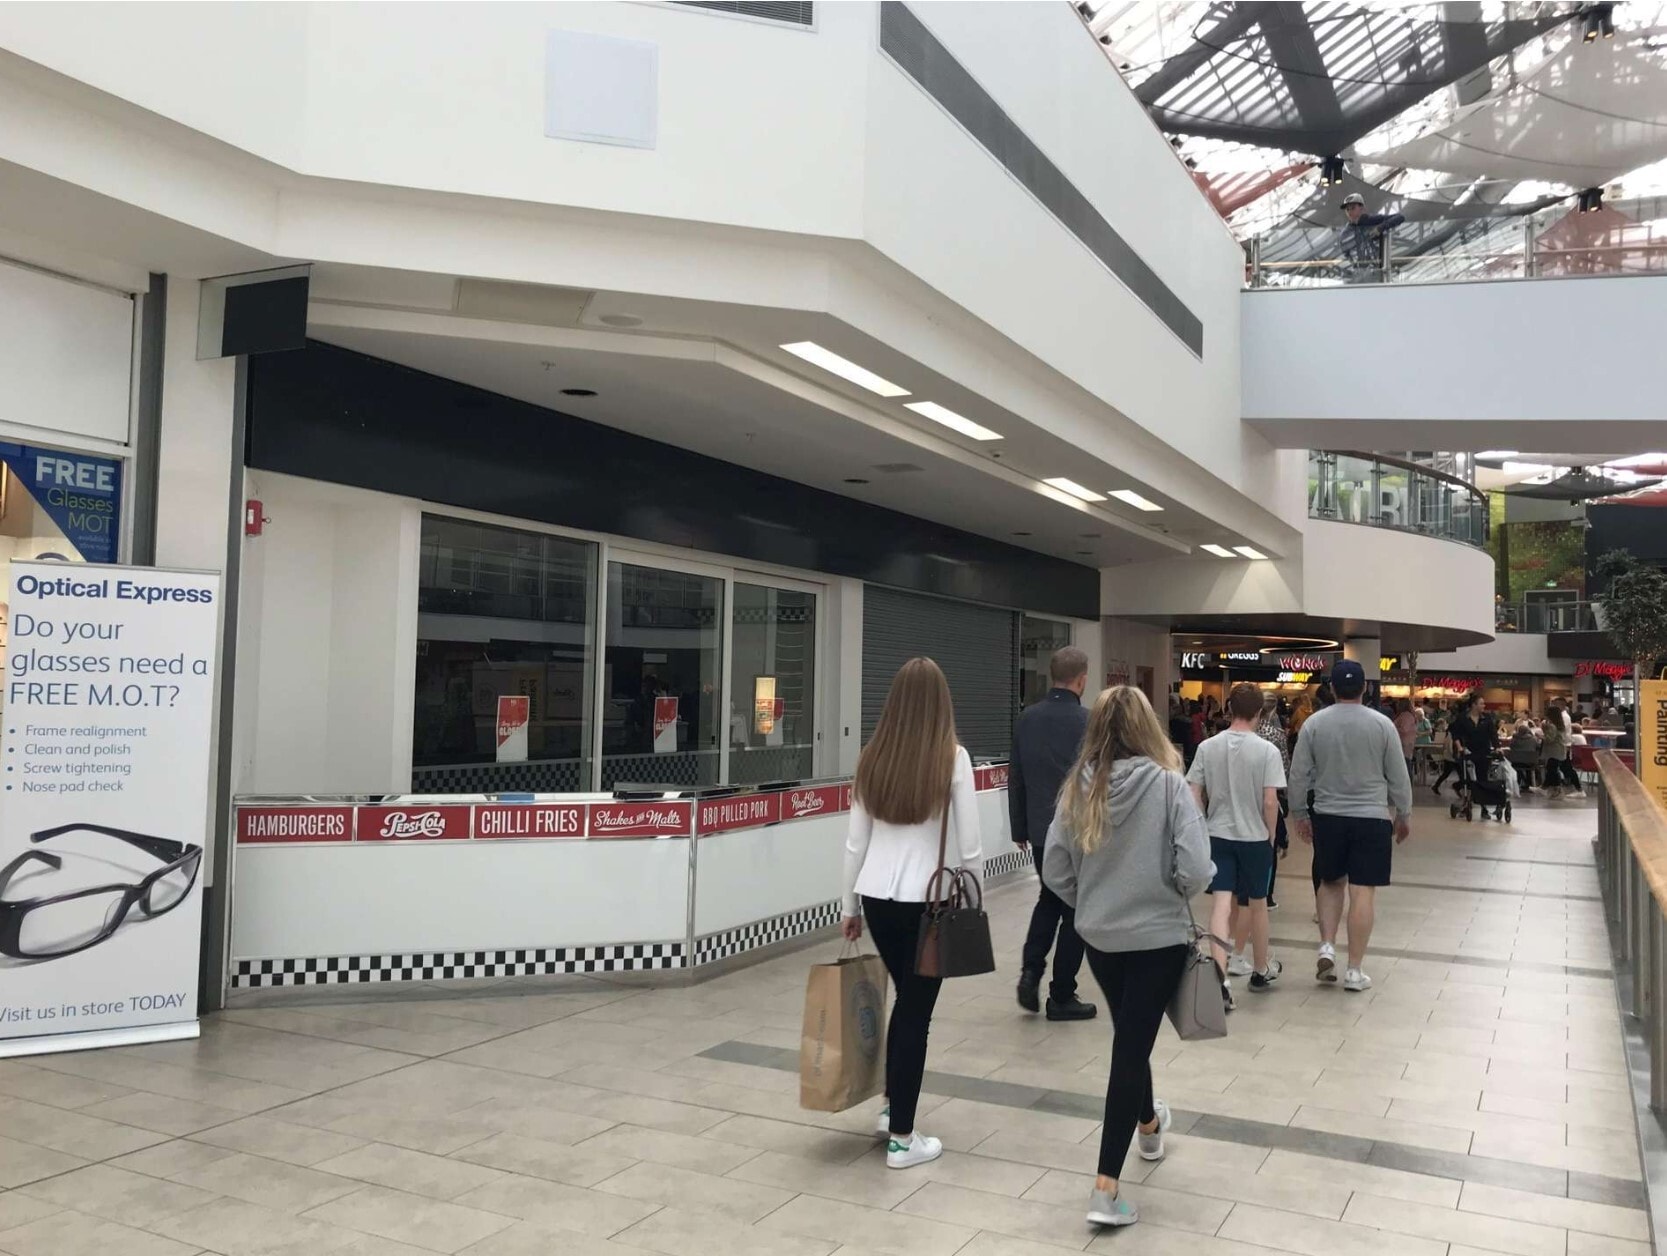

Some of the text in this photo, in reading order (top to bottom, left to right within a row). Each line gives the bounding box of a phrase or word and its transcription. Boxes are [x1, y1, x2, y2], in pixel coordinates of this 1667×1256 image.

[36, 456, 115, 491] FREE
[47, 487, 113, 512] Glasses
[68, 511, 113, 534] MOT
[17, 575, 213, 604] Optical Express
[14, 614, 124, 644] Do your
[11, 648, 207, 677] glasses need a
[1181, 653, 1205, 669] KFC
[1277, 672, 1313, 682] SUBWAY
[10, 682, 180, 707] FREE M.O.T?
[25, 725, 147, 739] Frame realignment
[24, 743, 131, 757] Clean and polish
[23, 762, 131, 776] Screw tightening
[22, 780, 124, 794] Nose pad check
[247, 814, 345, 836] HAMBURGERS
[481, 809, 578, 834] CHILLI FRIES
[594, 810, 634, 827] Shakes
[645, 809, 682, 829] Malts
[703, 800, 769, 828] BBQ PULLED PORK
[37, 1007, 56, 1020] us
[61, 1004, 77, 1017] in
[81, 1001, 125, 1016] store
[129, 993, 187, 1011] TODAY
